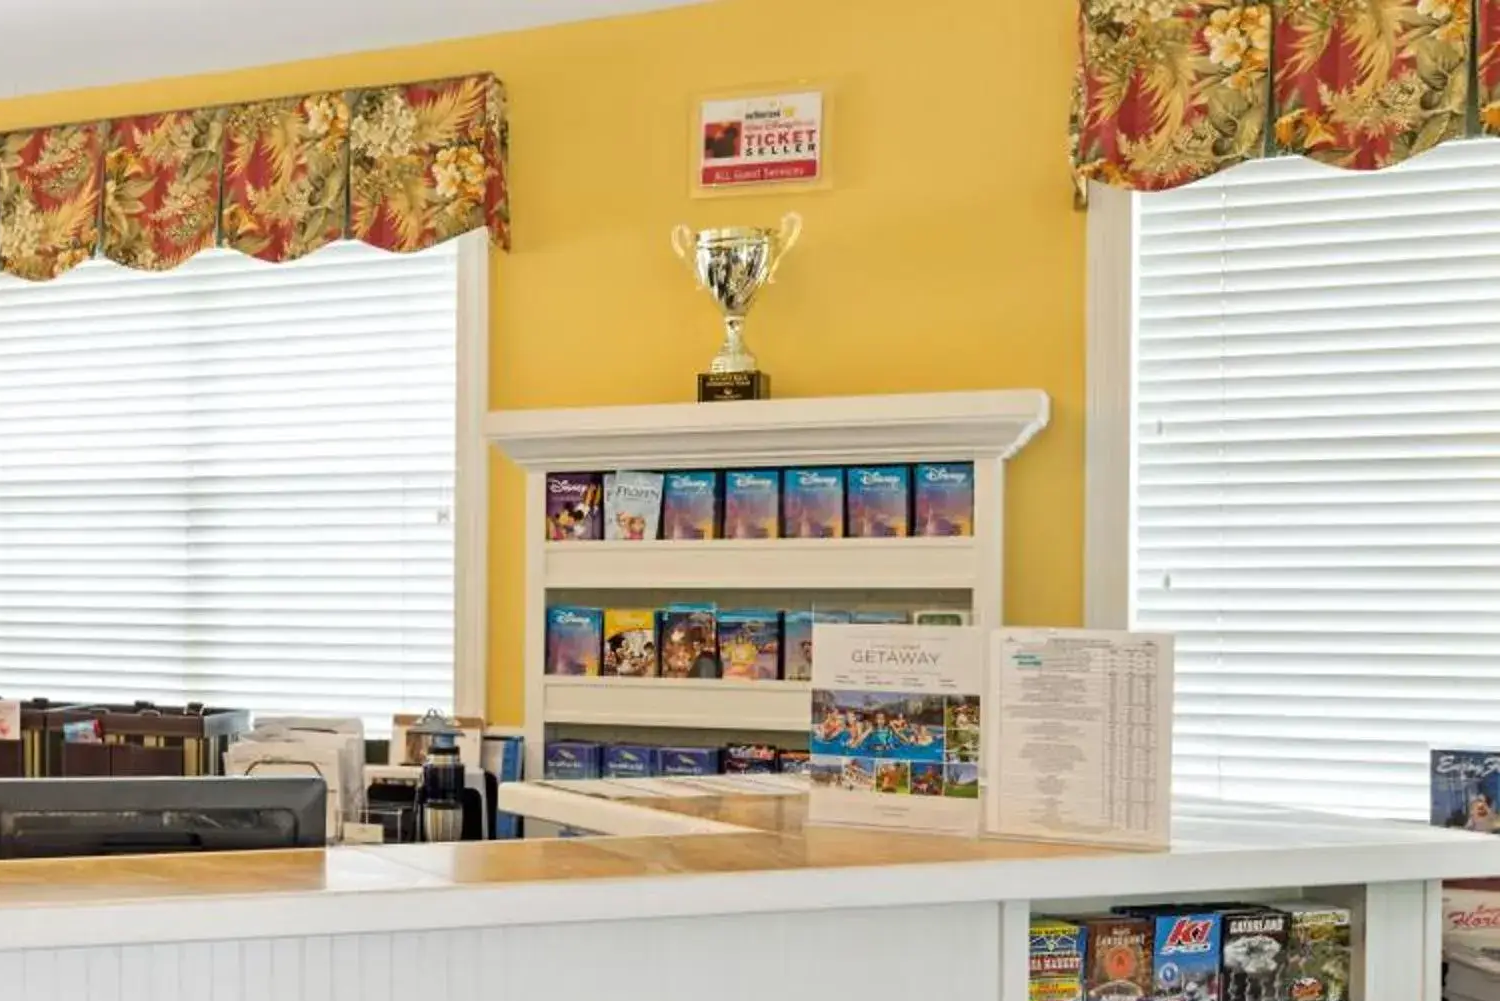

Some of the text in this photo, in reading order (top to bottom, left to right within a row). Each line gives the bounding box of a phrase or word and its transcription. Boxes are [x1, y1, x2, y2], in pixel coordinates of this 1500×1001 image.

[744, 129, 817, 147] TICKET
[744, 143, 816, 157] SELLER
[615, 485, 660, 499] FROZEN
[850, 648, 942, 666] GETAWAY
